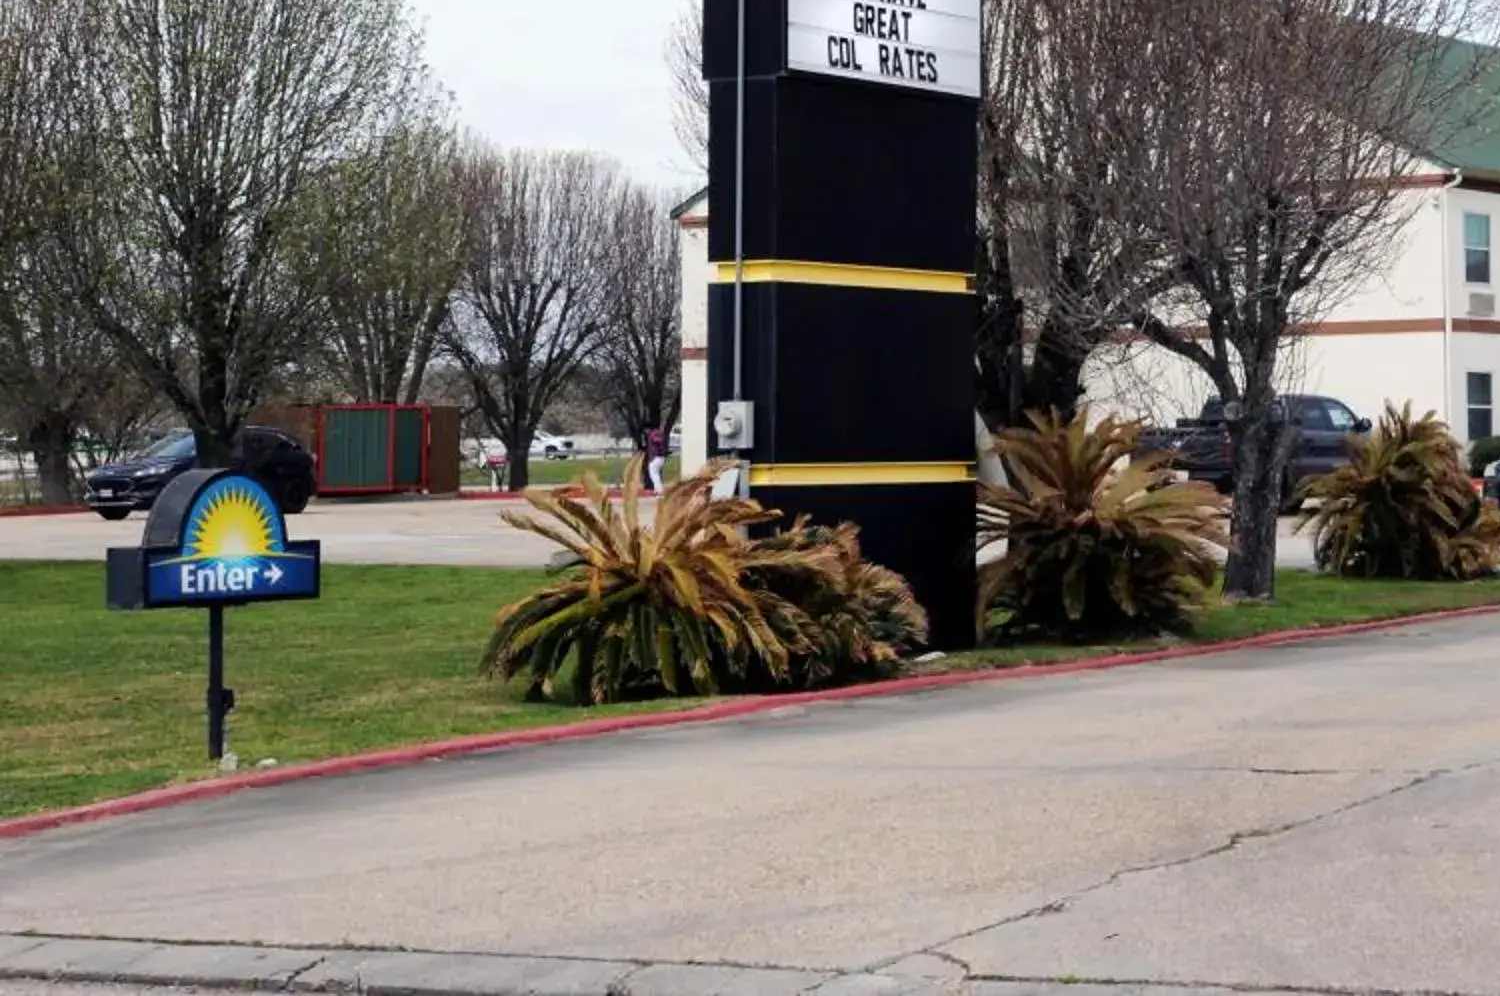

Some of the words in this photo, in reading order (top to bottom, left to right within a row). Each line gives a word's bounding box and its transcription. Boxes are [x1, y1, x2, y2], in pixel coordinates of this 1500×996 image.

[853, 2, 912, 43] GREAT
[827, 35, 863, 71] CDL
[878, 43, 938, 83] RATES
[180, 563, 258, 594] Enter
